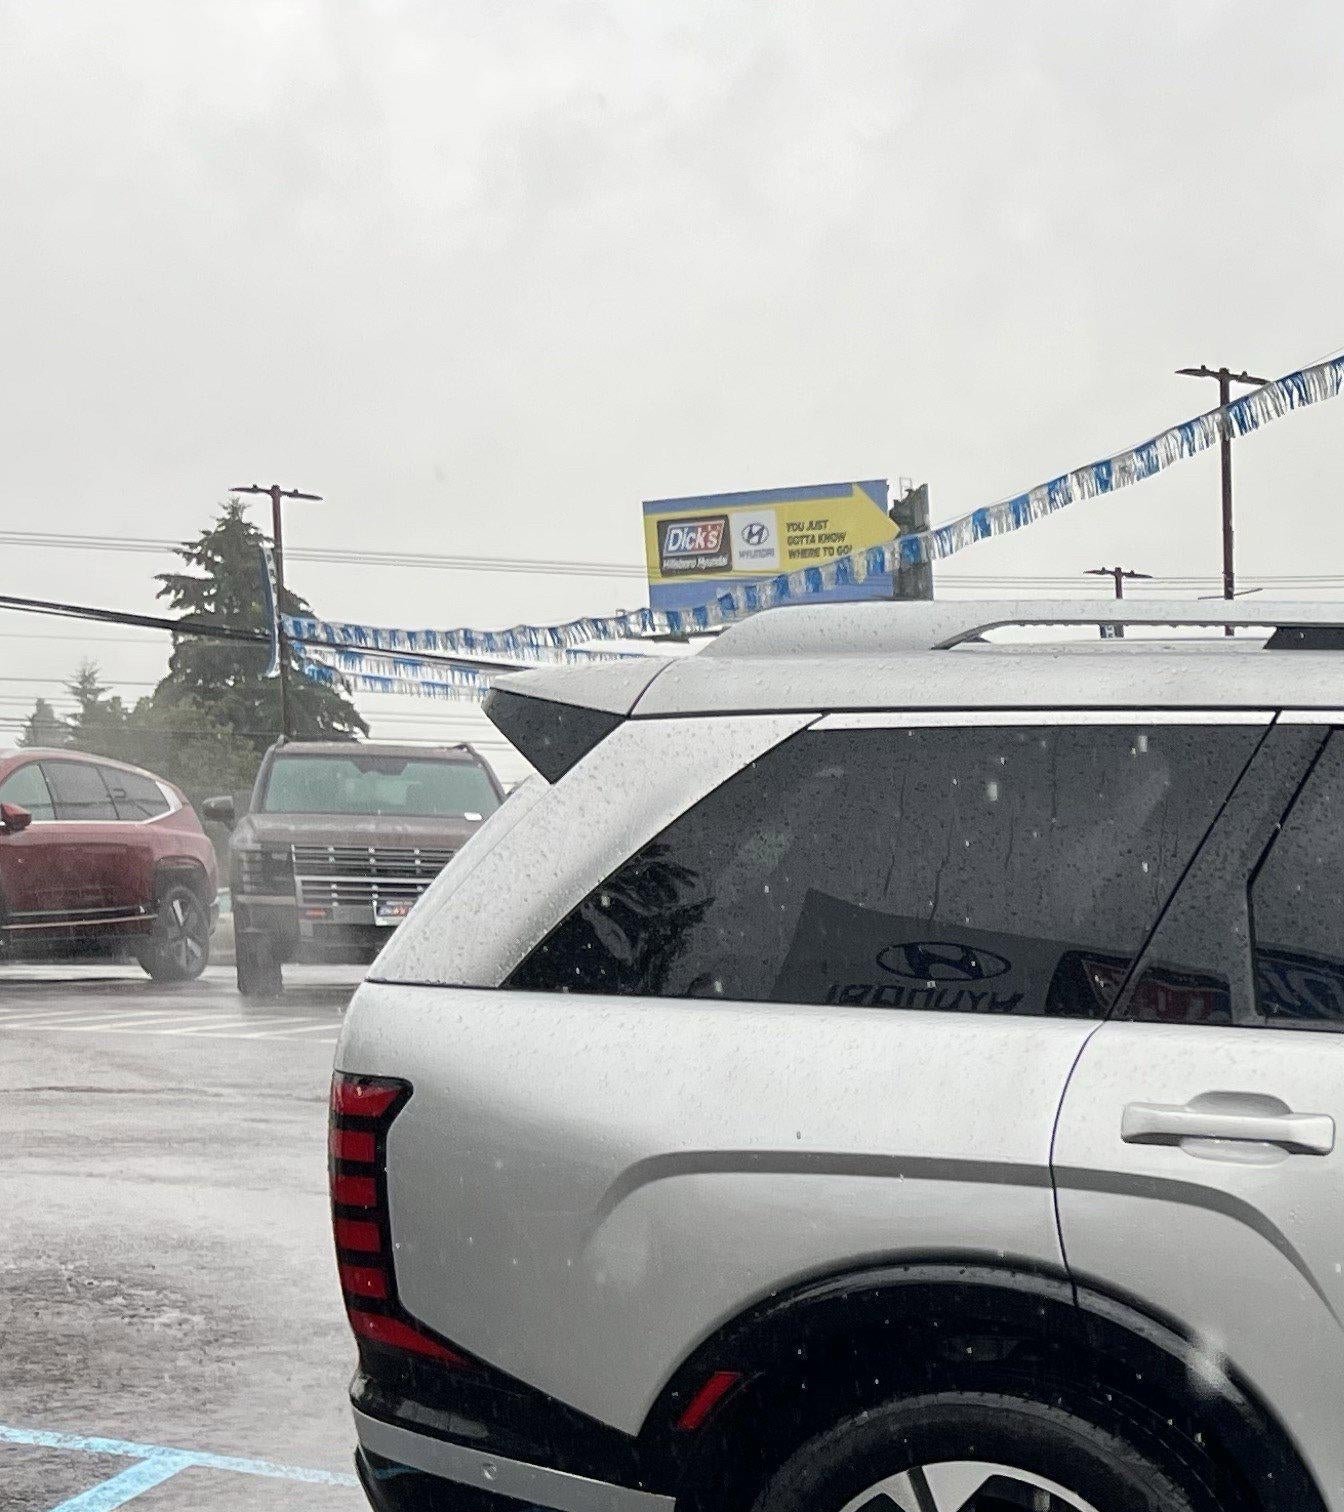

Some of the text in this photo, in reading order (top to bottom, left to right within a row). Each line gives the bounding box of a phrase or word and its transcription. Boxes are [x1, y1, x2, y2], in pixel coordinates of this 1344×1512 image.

[787, 520, 828, 532] YOU JUST
[818, 532, 846, 543] KNOW
[788, 548, 820, 559] WHERE
[822, 547, 835, 557] TO
